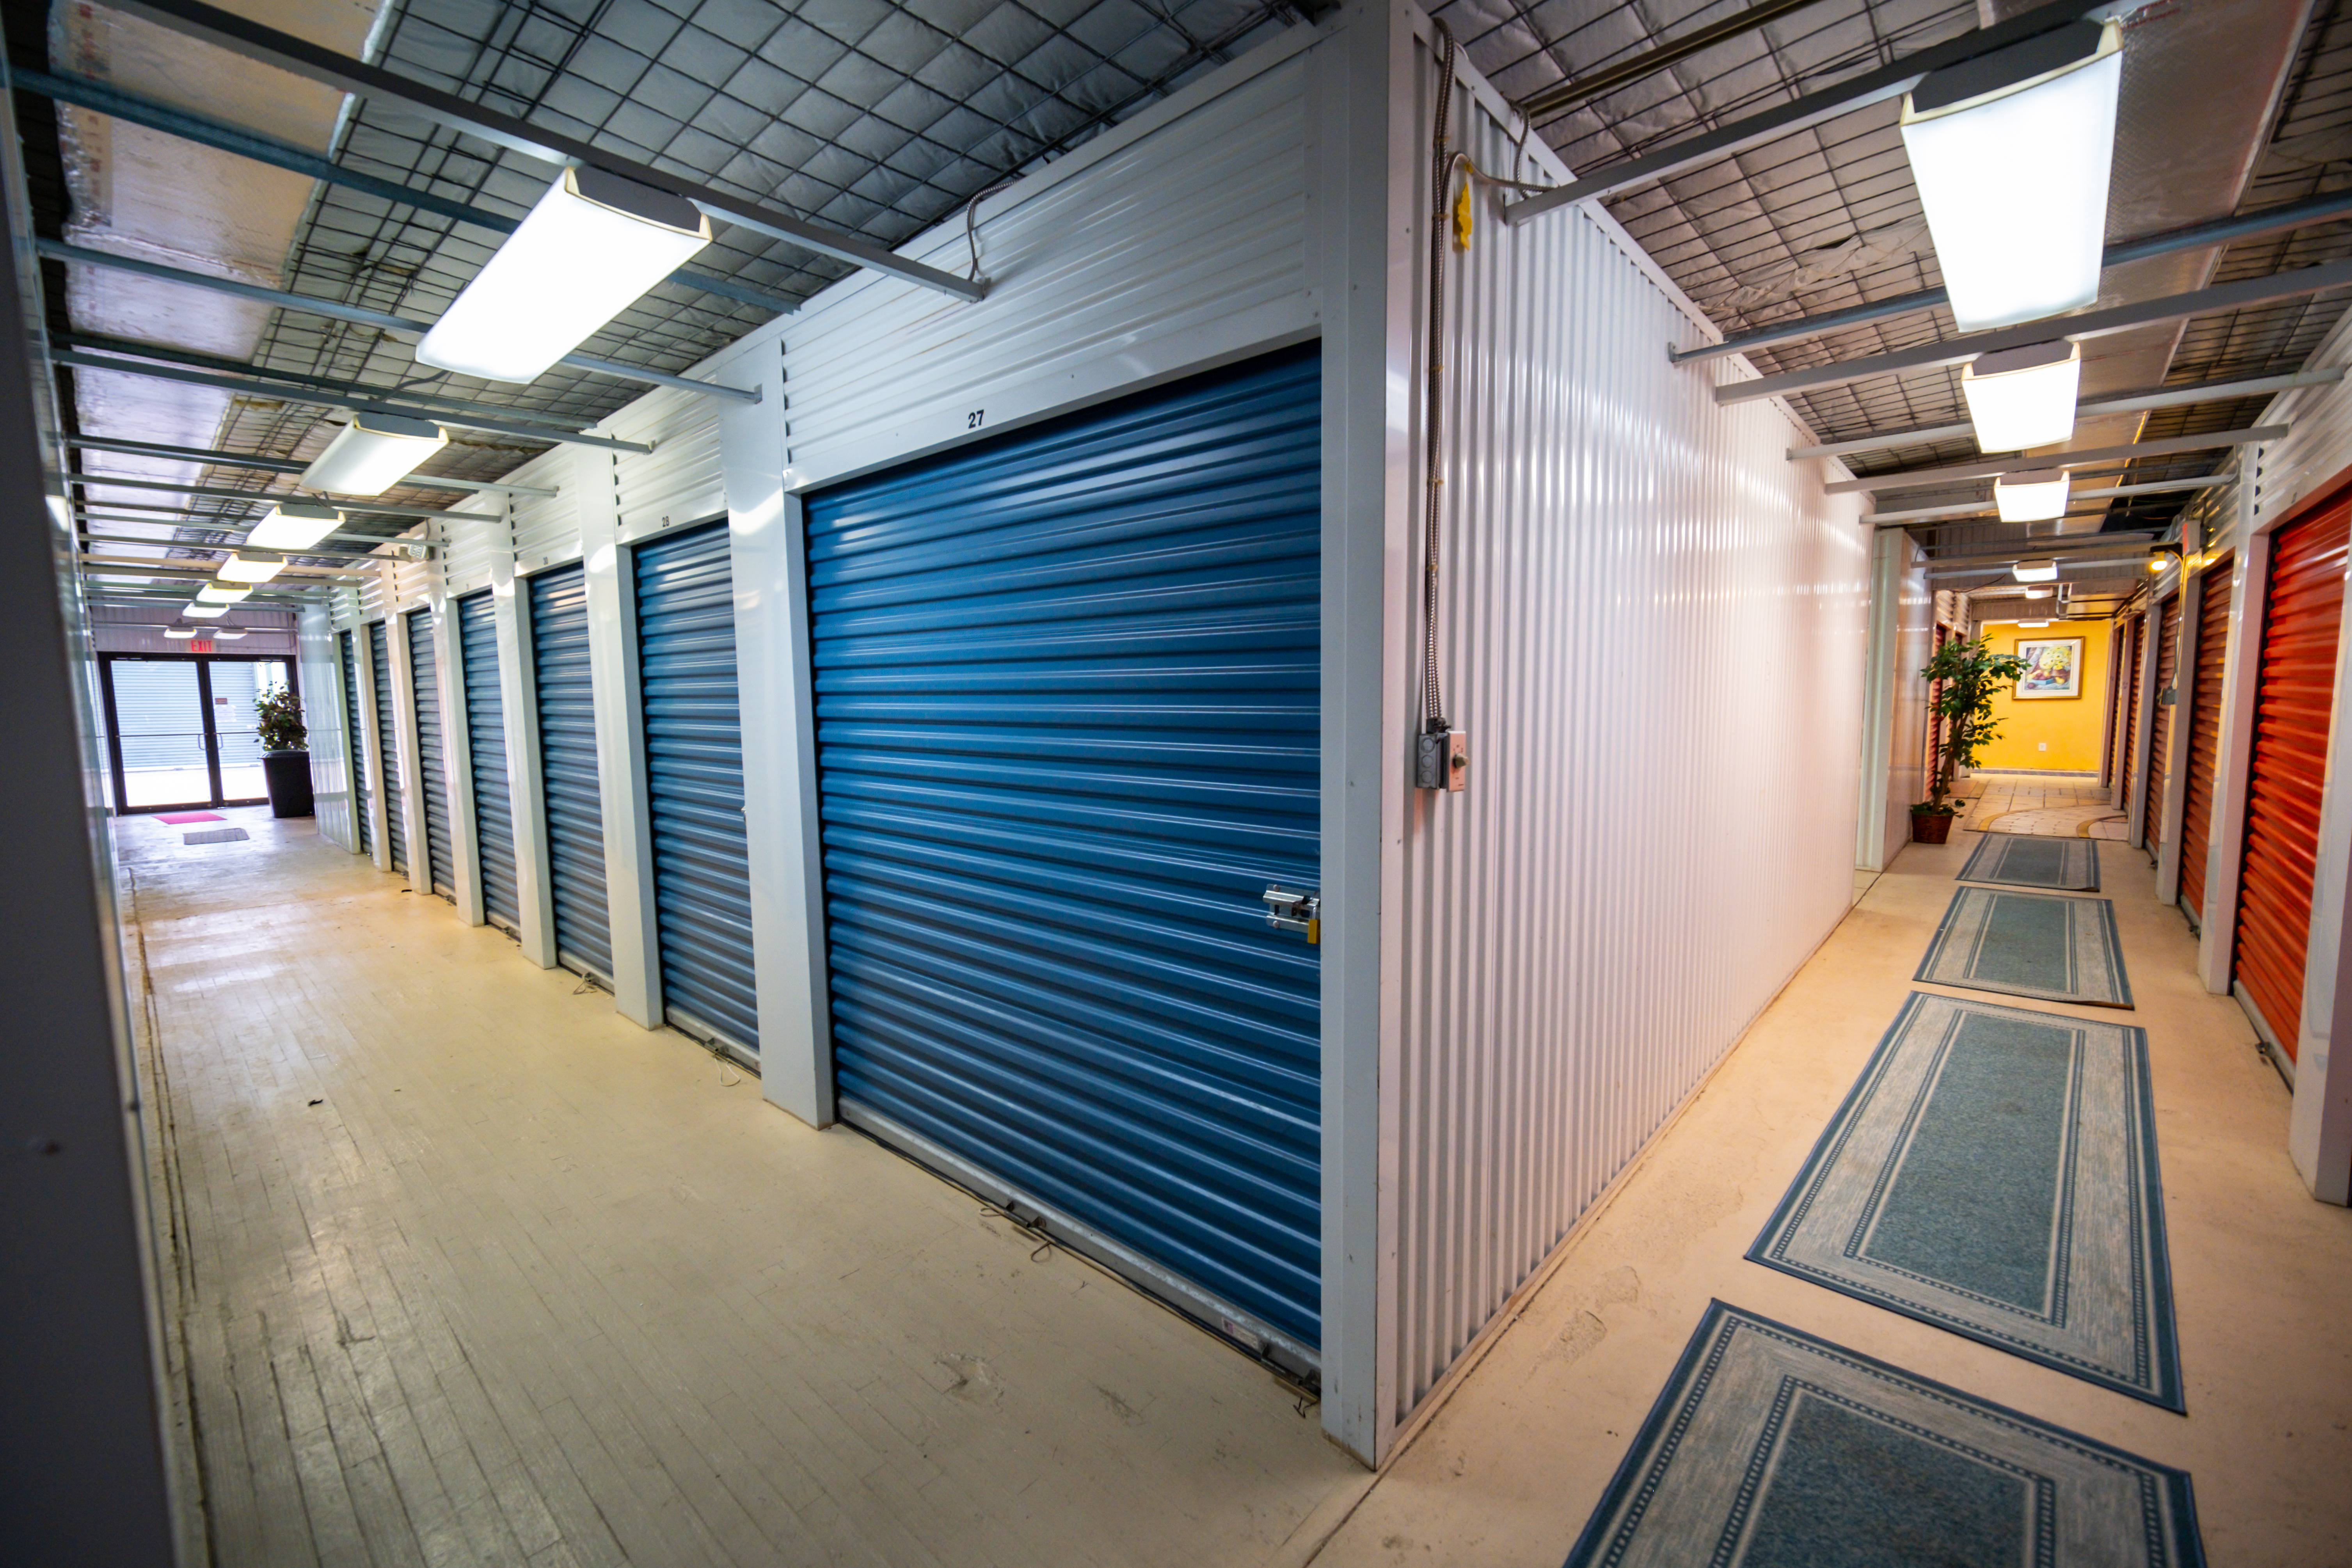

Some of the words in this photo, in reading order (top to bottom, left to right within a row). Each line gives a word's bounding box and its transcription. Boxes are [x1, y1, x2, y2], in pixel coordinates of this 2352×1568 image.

[968, 409, 984, 429] 27
[662, 516, 670, 527] 28
[191, 640, 212, 652] EXIT
